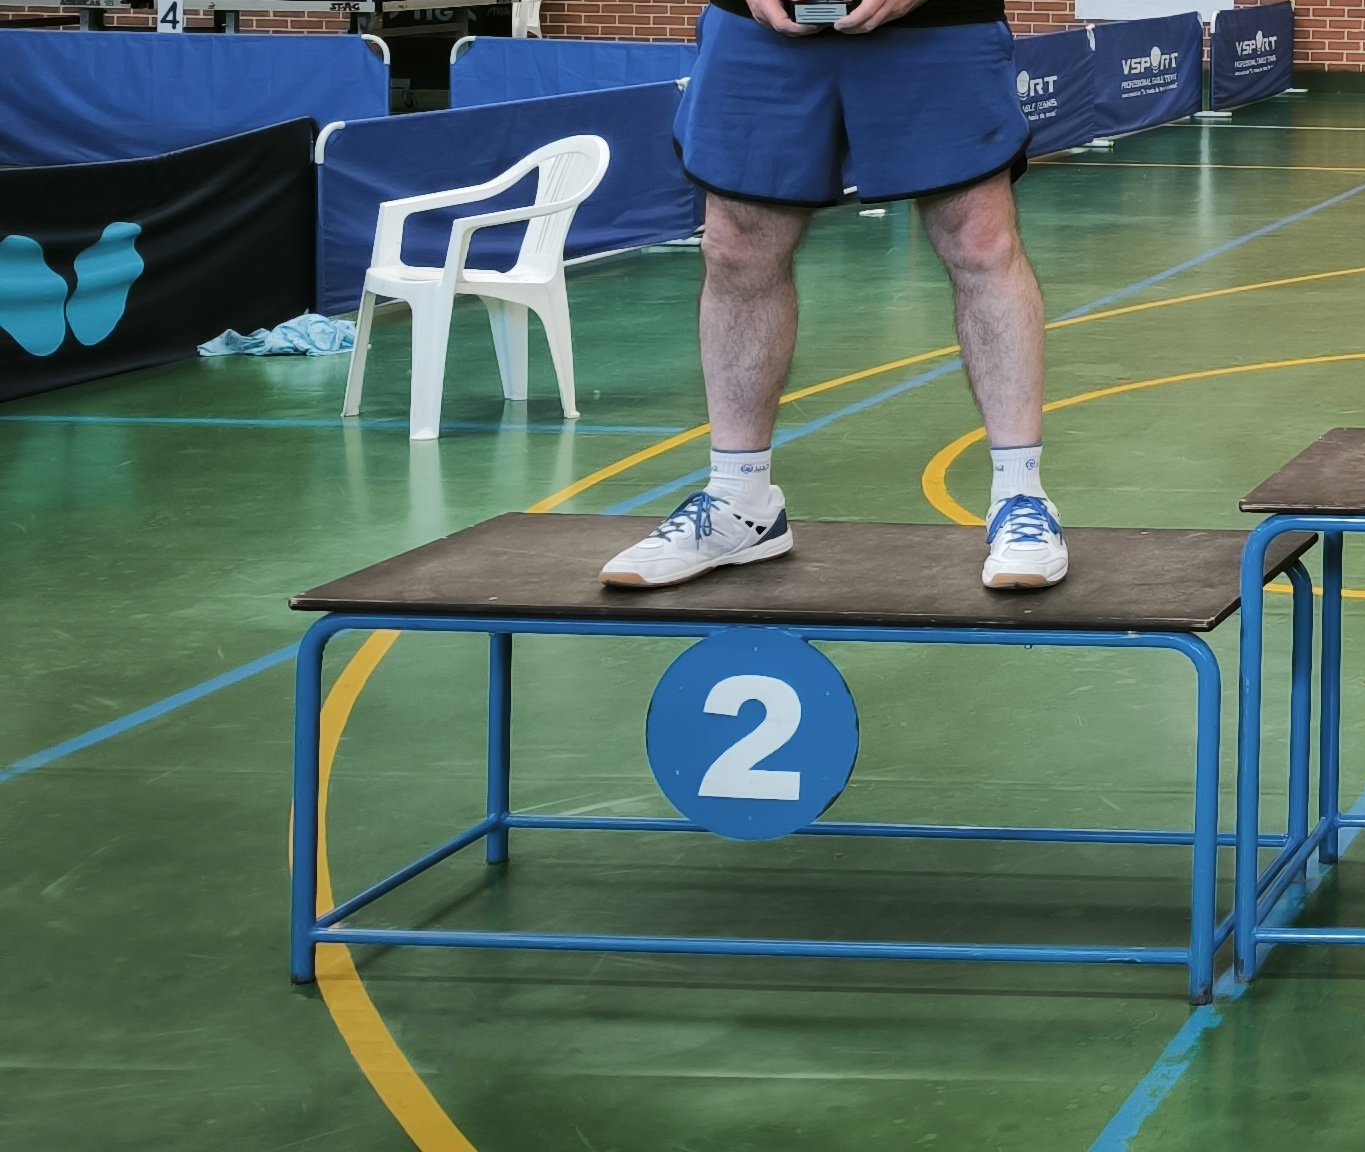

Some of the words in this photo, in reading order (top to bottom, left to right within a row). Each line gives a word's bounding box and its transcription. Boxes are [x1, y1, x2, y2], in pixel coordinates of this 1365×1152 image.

[159, 1, 180, 30] 4
[1121, 46, 1179, 75] VSPORT
[1016, 70, 1058, 101] ORT
[697, 674, 803, 802] 2
